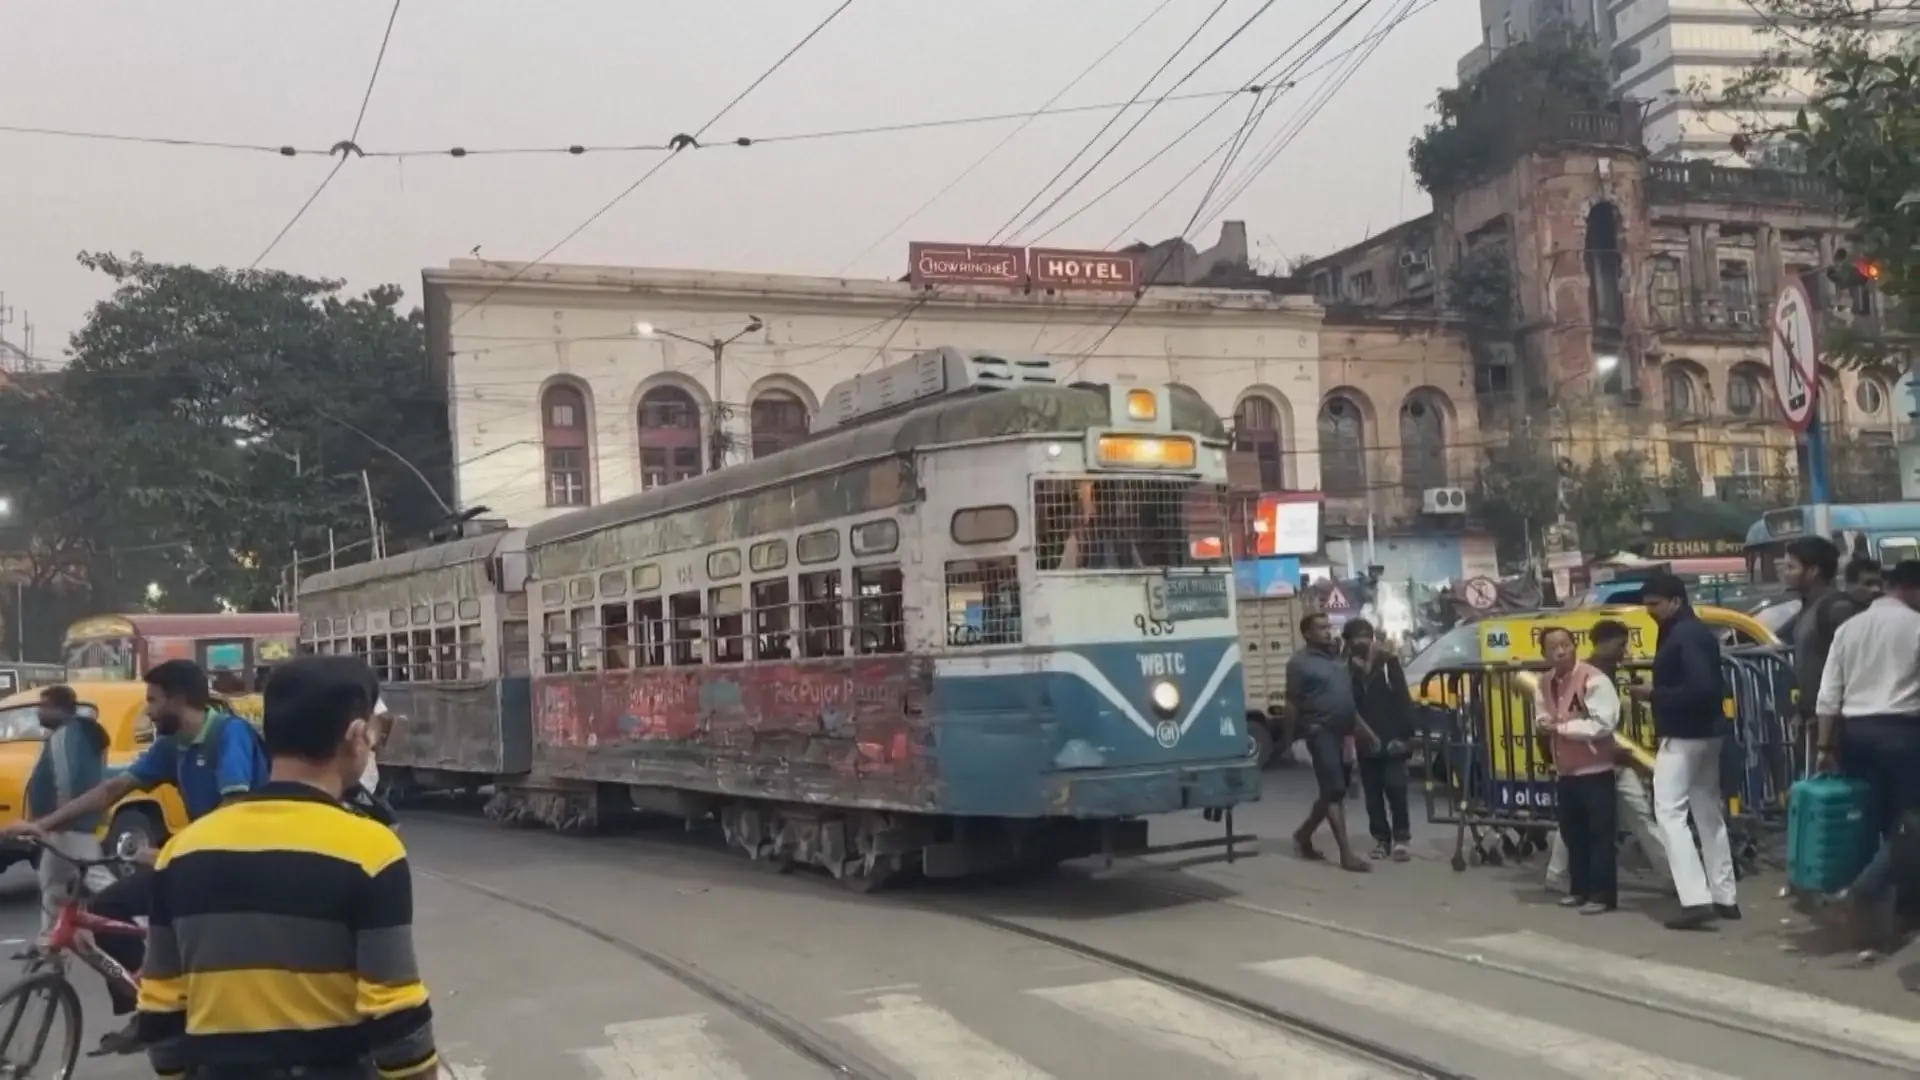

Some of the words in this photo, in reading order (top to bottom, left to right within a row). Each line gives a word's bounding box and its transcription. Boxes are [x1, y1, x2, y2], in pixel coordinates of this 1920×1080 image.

[1049, 260, 1123, 279] HOTEL
[1652, 541, 1709, 556] ZEESHAN
[1136, 652, 1185, 676] WBTC
[1567, 691, 1583, 712] A
